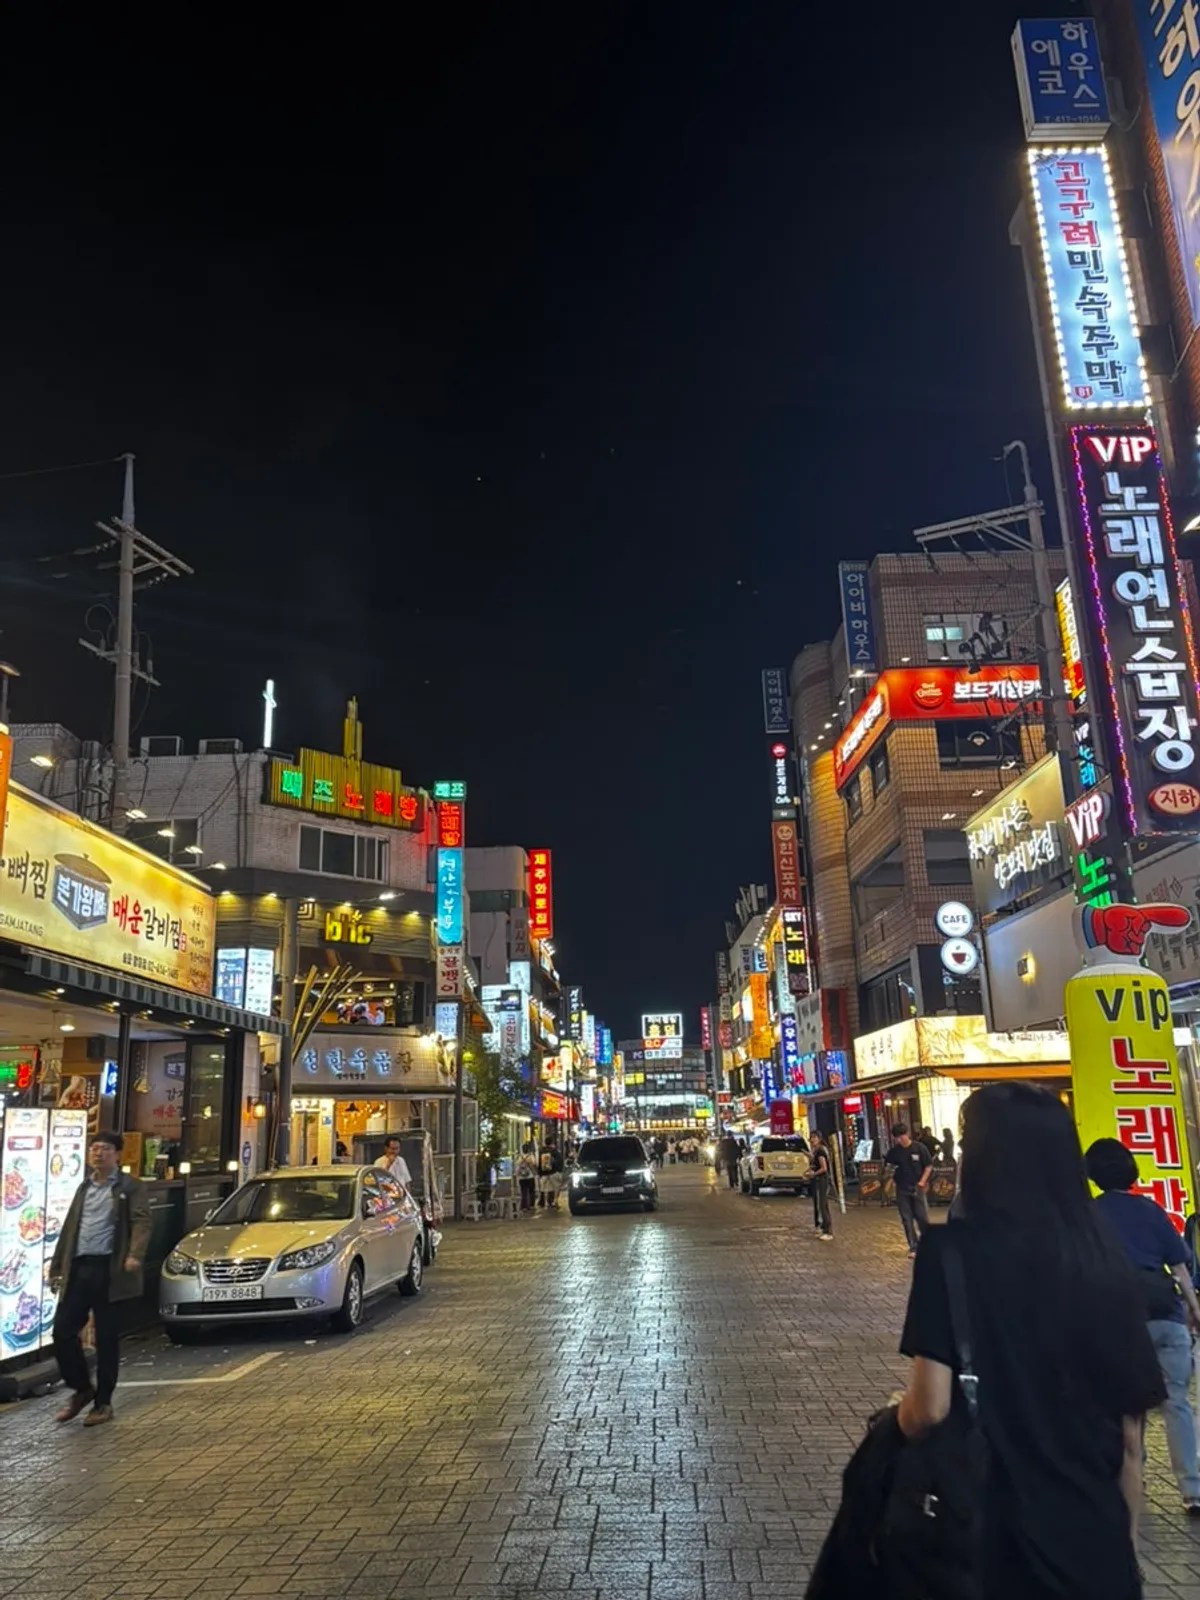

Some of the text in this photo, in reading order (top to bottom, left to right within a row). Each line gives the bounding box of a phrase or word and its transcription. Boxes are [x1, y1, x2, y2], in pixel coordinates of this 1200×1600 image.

[1031, 22, 1100, 108] 에코 하우스
[846, 573, 867, 616] 아이비
[851, 619, 870, 660] 하우스
[1099, 471, 1198, 772] 노래연습장
[344, 783, 417, 820] 노래방
[1160, 788, 1197, 808] 지하
[440, 802, 461, 847] 노래방
[779, 842, 798, 900] 한신포차
[942, 914, 969, 924] CAFE
[440, 956, 460, 994] 골뱅이
[1095, 980, 1168, 1030] vip
[231, 1288, 257, 1298] 8848
